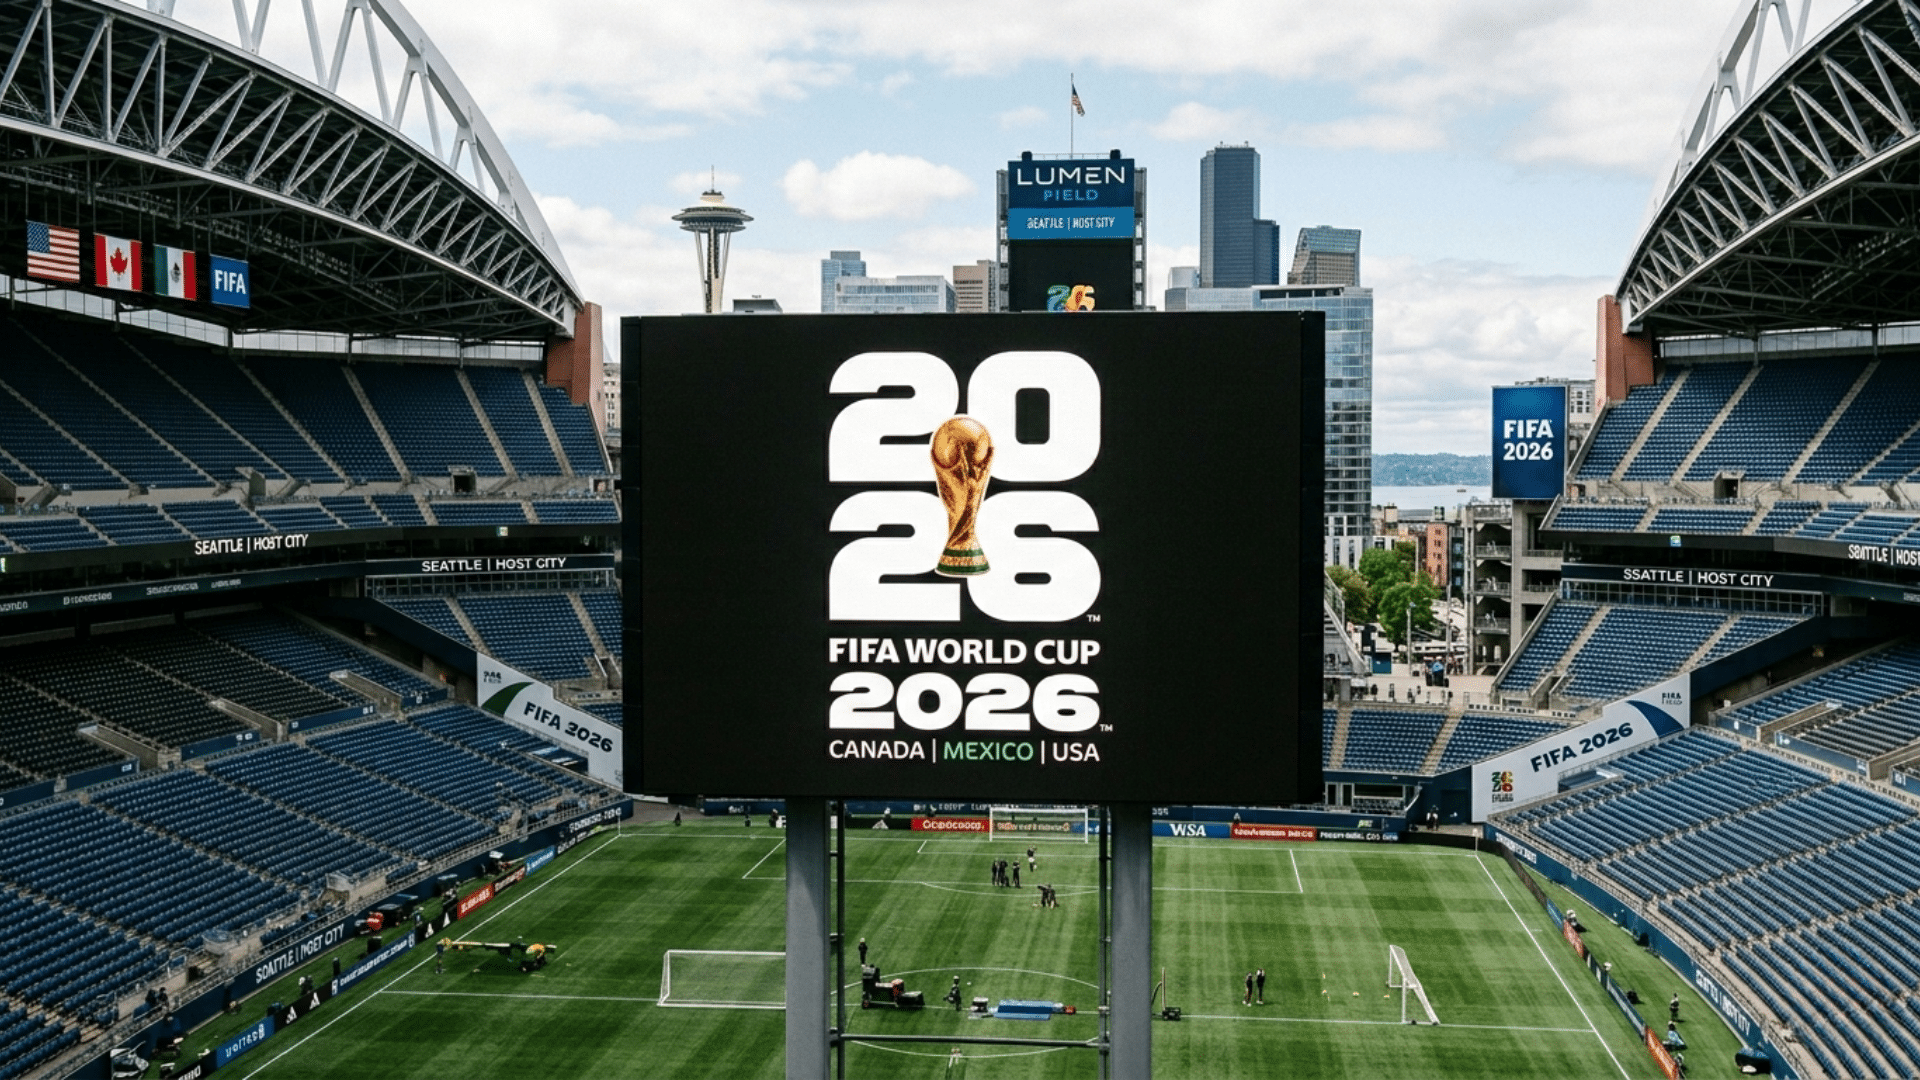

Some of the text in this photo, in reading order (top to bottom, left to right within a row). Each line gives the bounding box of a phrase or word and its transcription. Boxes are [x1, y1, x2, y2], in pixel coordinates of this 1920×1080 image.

[1017, 166, 1125, 185] LUMEN
[214, 269, 246, 295] FIFA
[829, 351, 1101, 482] 20
[1503, 419, 1554, 439] FIFA
[1503, 442, 1554, 461] 2026
[421, 557, 566, 572] SEATTLE HOST CITY
[829, 490, 1101, 622] 26
[1698, 571, 1737, 585] HOST
[1740, 574, 1774, 587] CITY
[829, 638, 1100, 665] FIFA WORLD CUP
[829, 671, 1101, 732] 2026
[524, 702, 613, 753] FIFA 2026
[829, 740, 1101, 762] CANADA MEXICO USA
[1530, 722, 1634, 772] FIFA 2026
[1169, 823, 1207, 837] WSA
